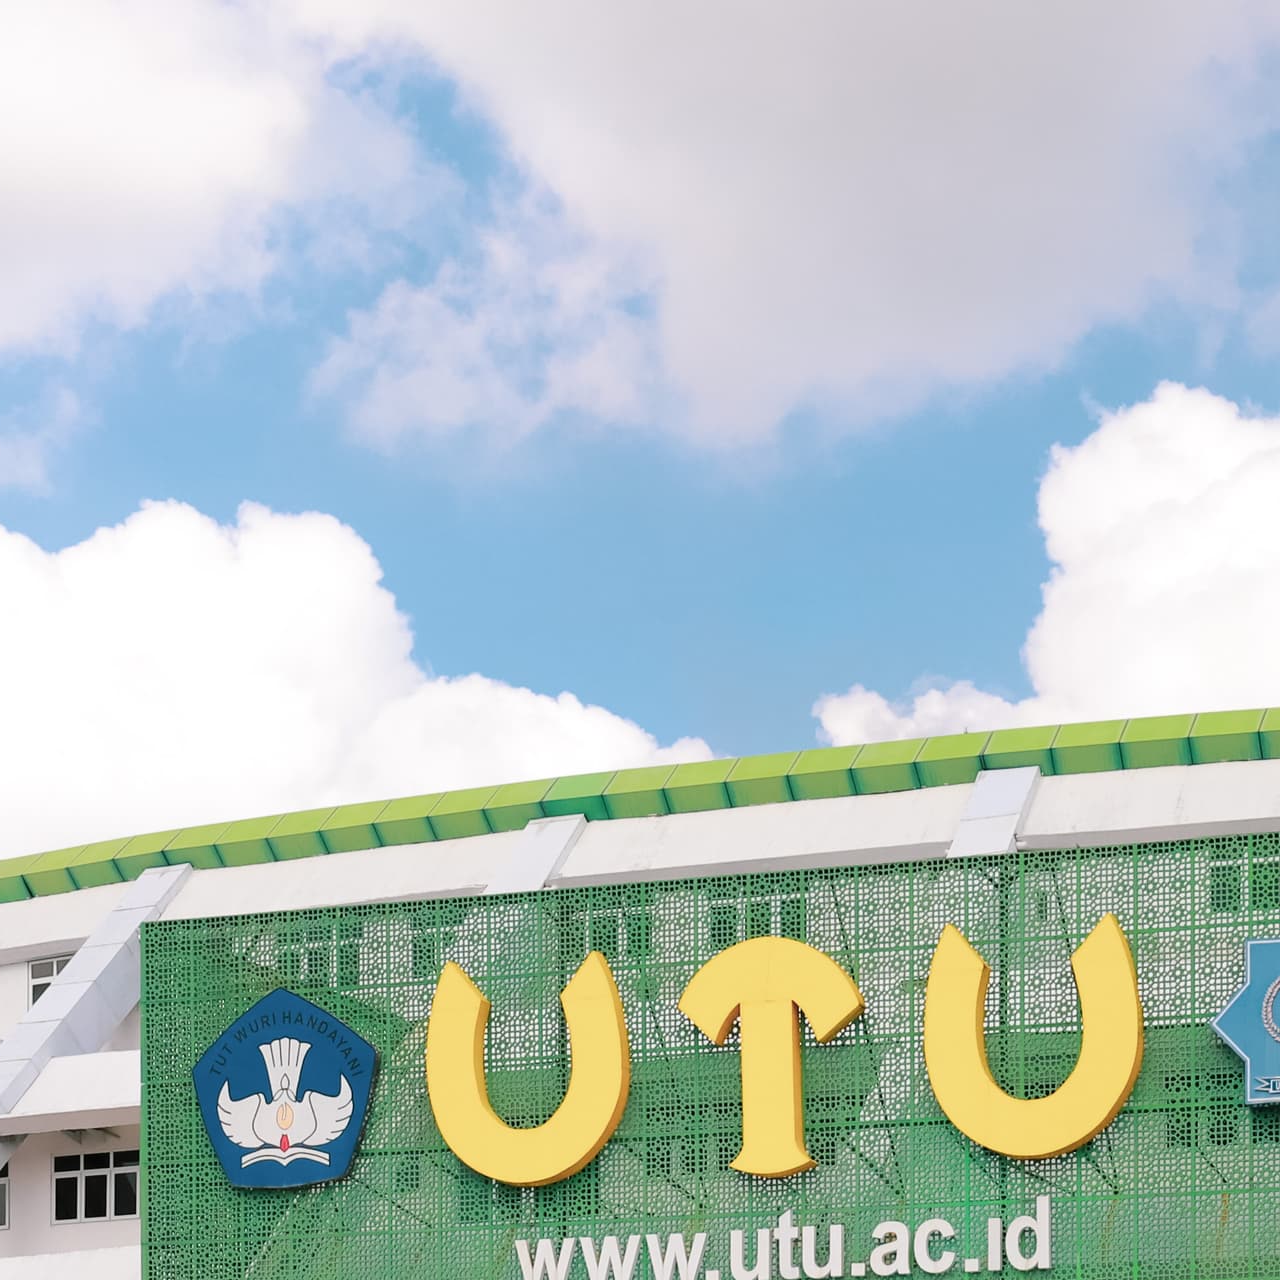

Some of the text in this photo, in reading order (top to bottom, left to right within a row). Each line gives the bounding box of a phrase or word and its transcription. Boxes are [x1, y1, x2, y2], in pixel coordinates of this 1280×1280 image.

[210, 1011, 363, 1077] TUT WURI HANDAYANI
[425, 912, 1144, 1187] UTU
